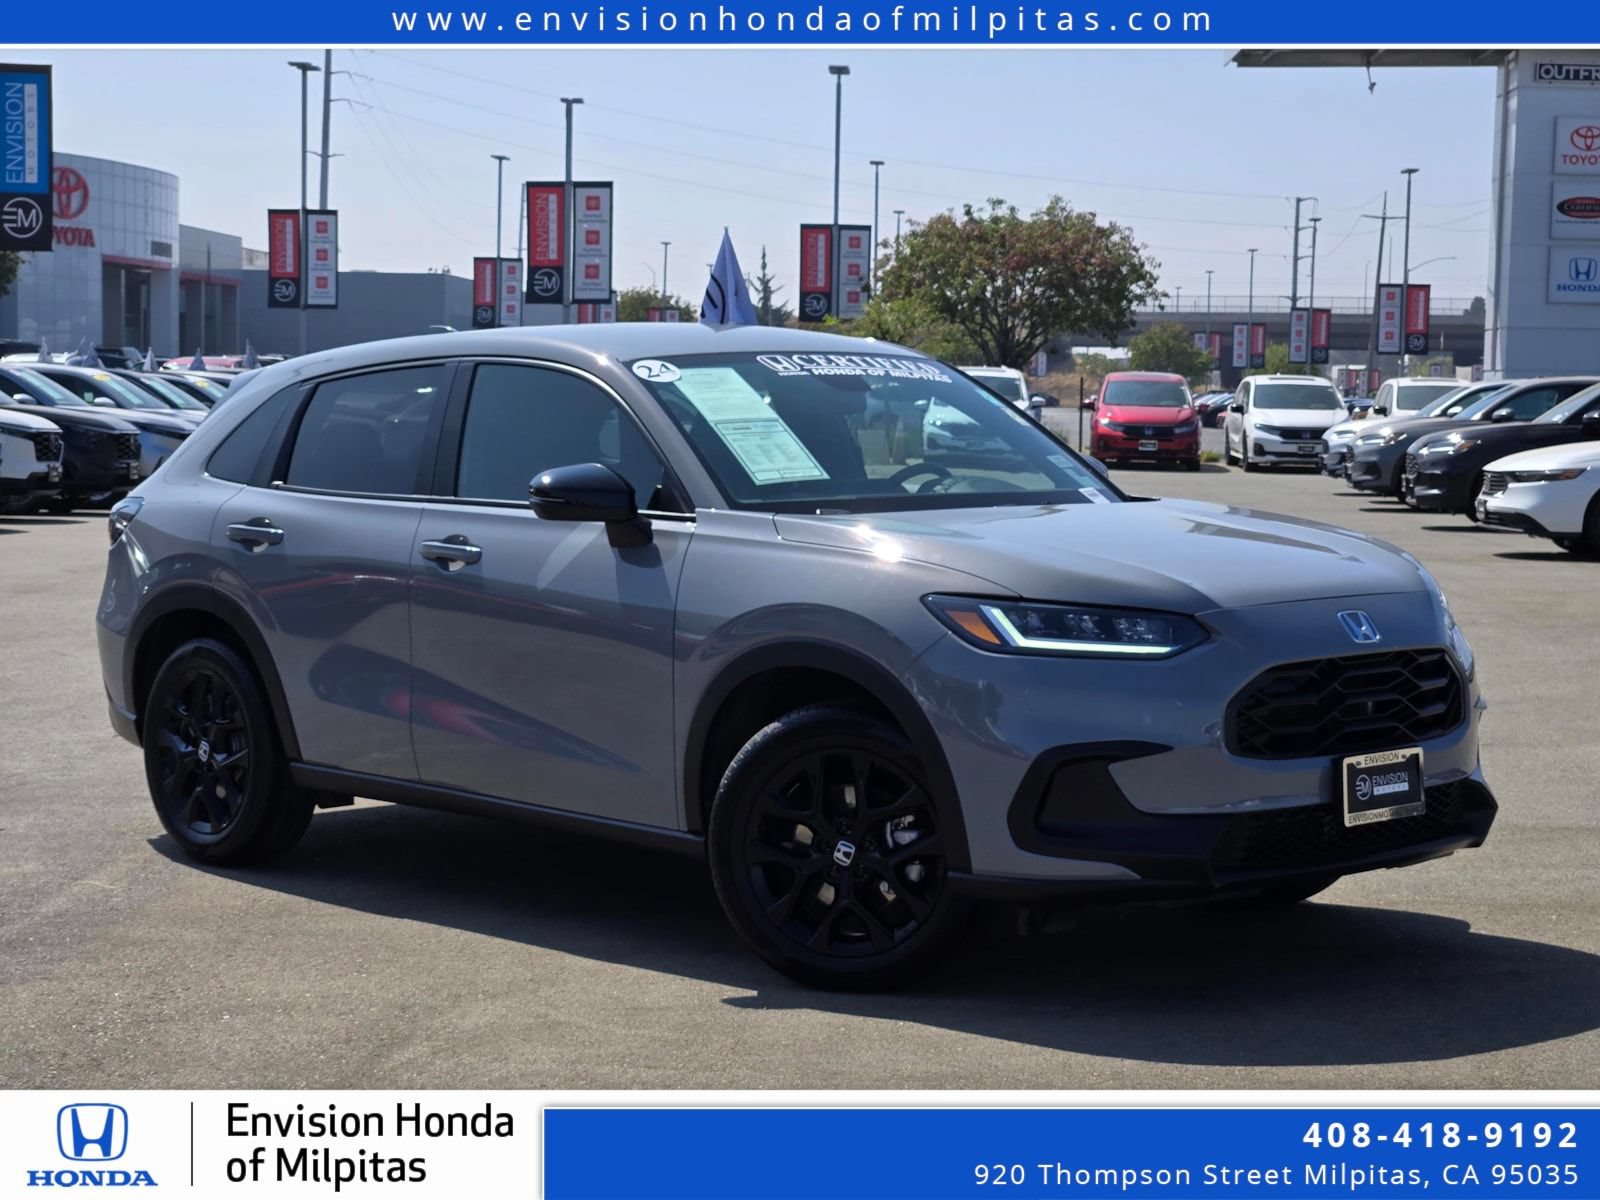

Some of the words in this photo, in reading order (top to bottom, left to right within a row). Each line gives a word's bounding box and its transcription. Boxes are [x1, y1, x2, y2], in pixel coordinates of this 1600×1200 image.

[5, 82, 24, 183] ENVISION
[27, 93, 36, 176] MOTORS
[1561, 154, 1600, 166] TOYO
[536, 193, 548, 260] ENVISION
[53, 226, 96, 247] YOTA
[1556, 284, 1600, 293] HOND
[637, 363, 677, 378] 24
[791, 354, 940, 375] CERTIFIED
[811, 368, 866, 377] HONDA
[867, 369, 886, 377] OF
[1364, 751, 1400, 766] ENVISION
[1372, 771, 1408, 787] ENVISION
